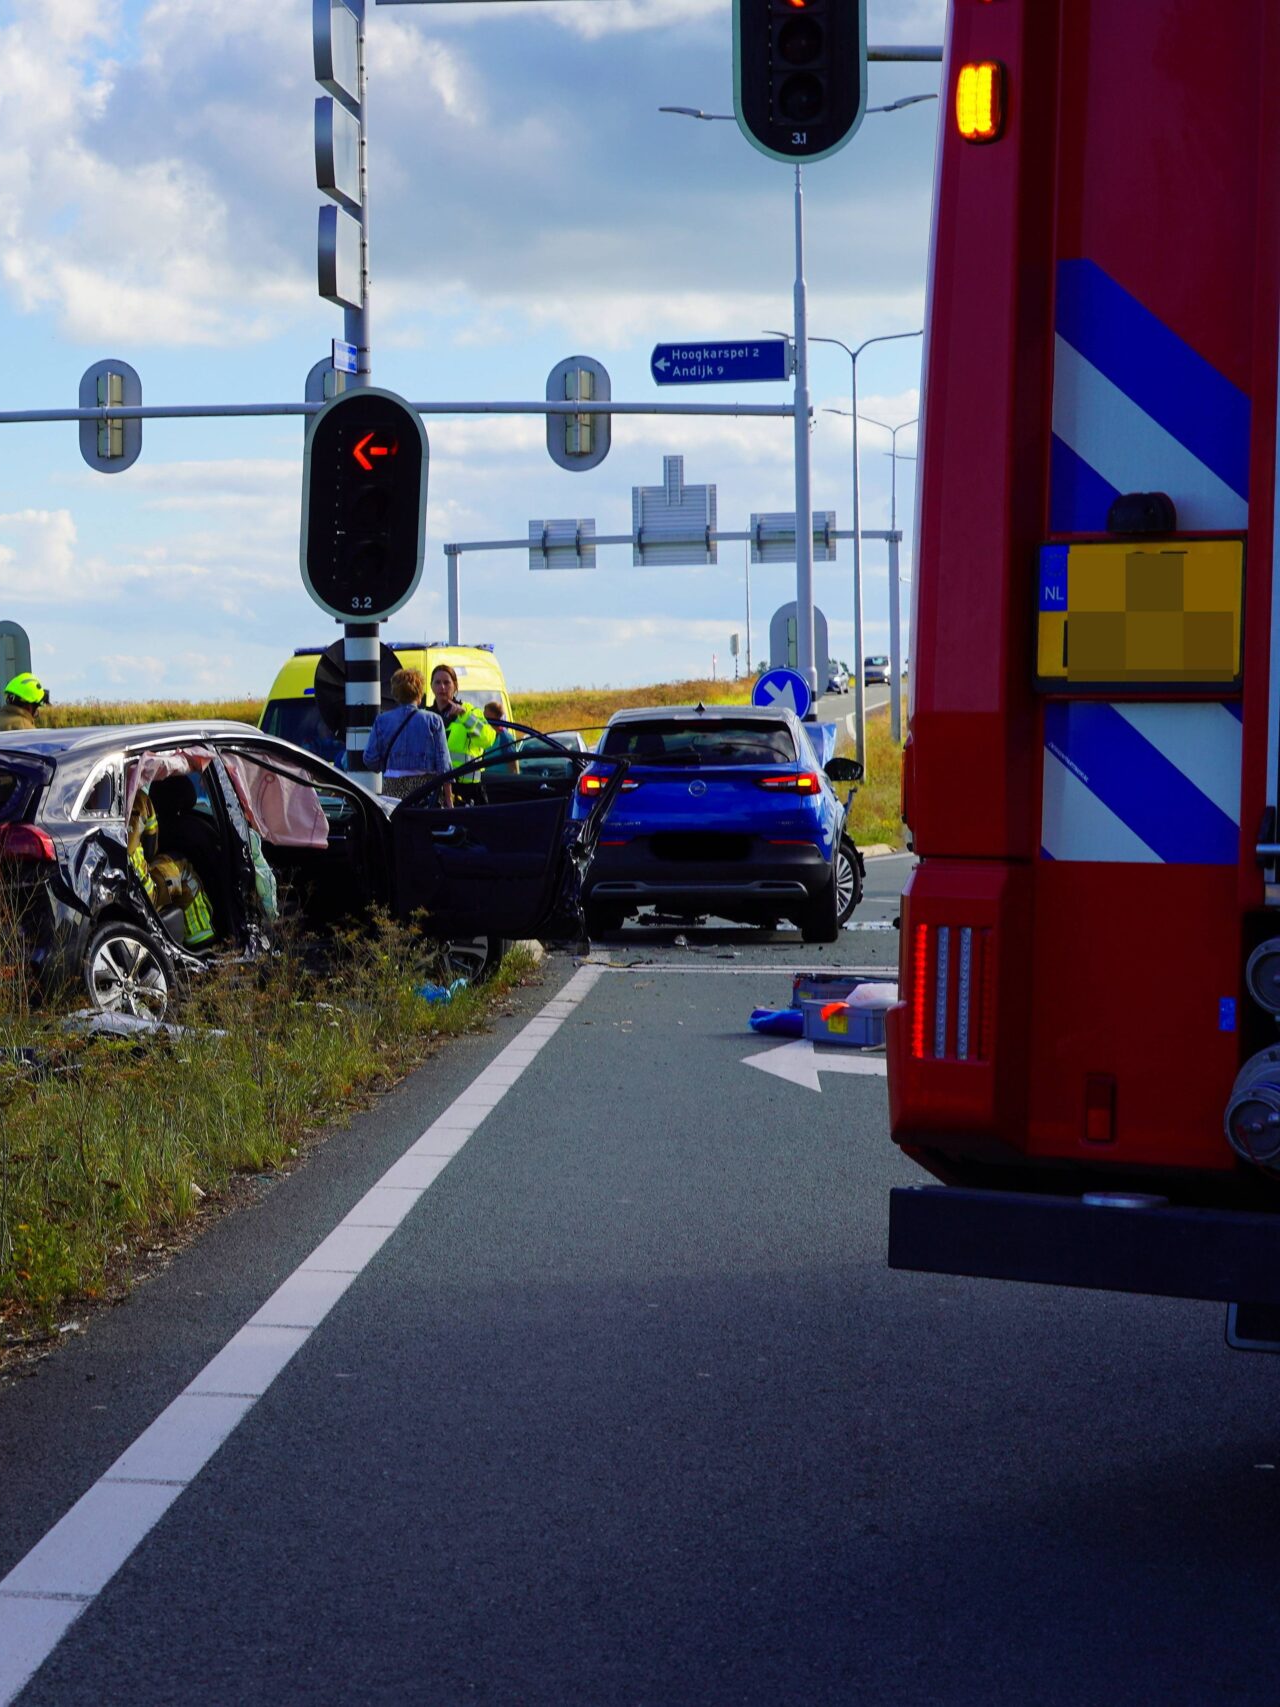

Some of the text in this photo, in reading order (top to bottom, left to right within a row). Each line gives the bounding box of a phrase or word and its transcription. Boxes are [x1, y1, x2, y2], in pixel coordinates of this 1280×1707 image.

[791, 132, 807, 145] 3.1
[672, 347, 760, 363] Hoogkarspel 2
[672, 365, 724, 379] Andijk 9
[1045, 586, 1064, 600] NL
[351, 596, 372, 609] 3.2
